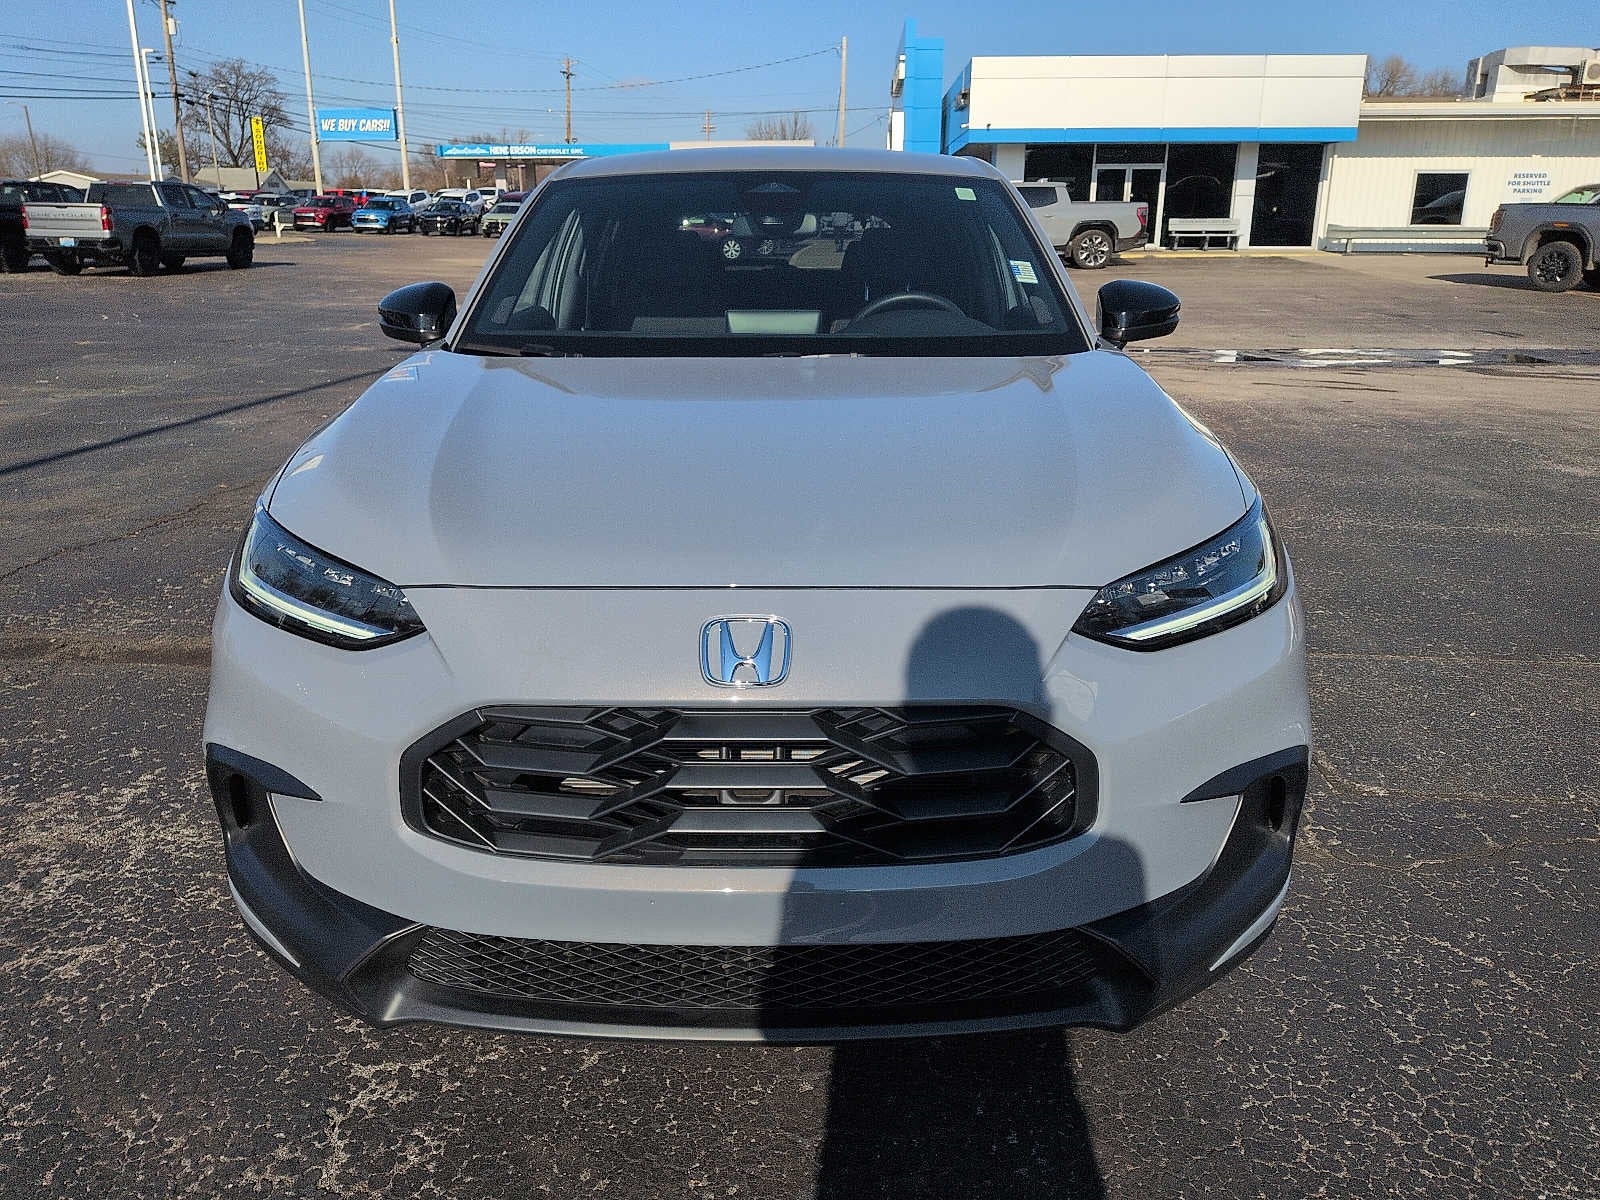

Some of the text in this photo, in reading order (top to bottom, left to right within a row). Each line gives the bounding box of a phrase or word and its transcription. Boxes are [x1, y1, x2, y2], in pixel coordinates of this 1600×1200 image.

[321, 119, 390, 132] WE BUY CARS!!
[490, 146, 536, 155] HENDERSON
